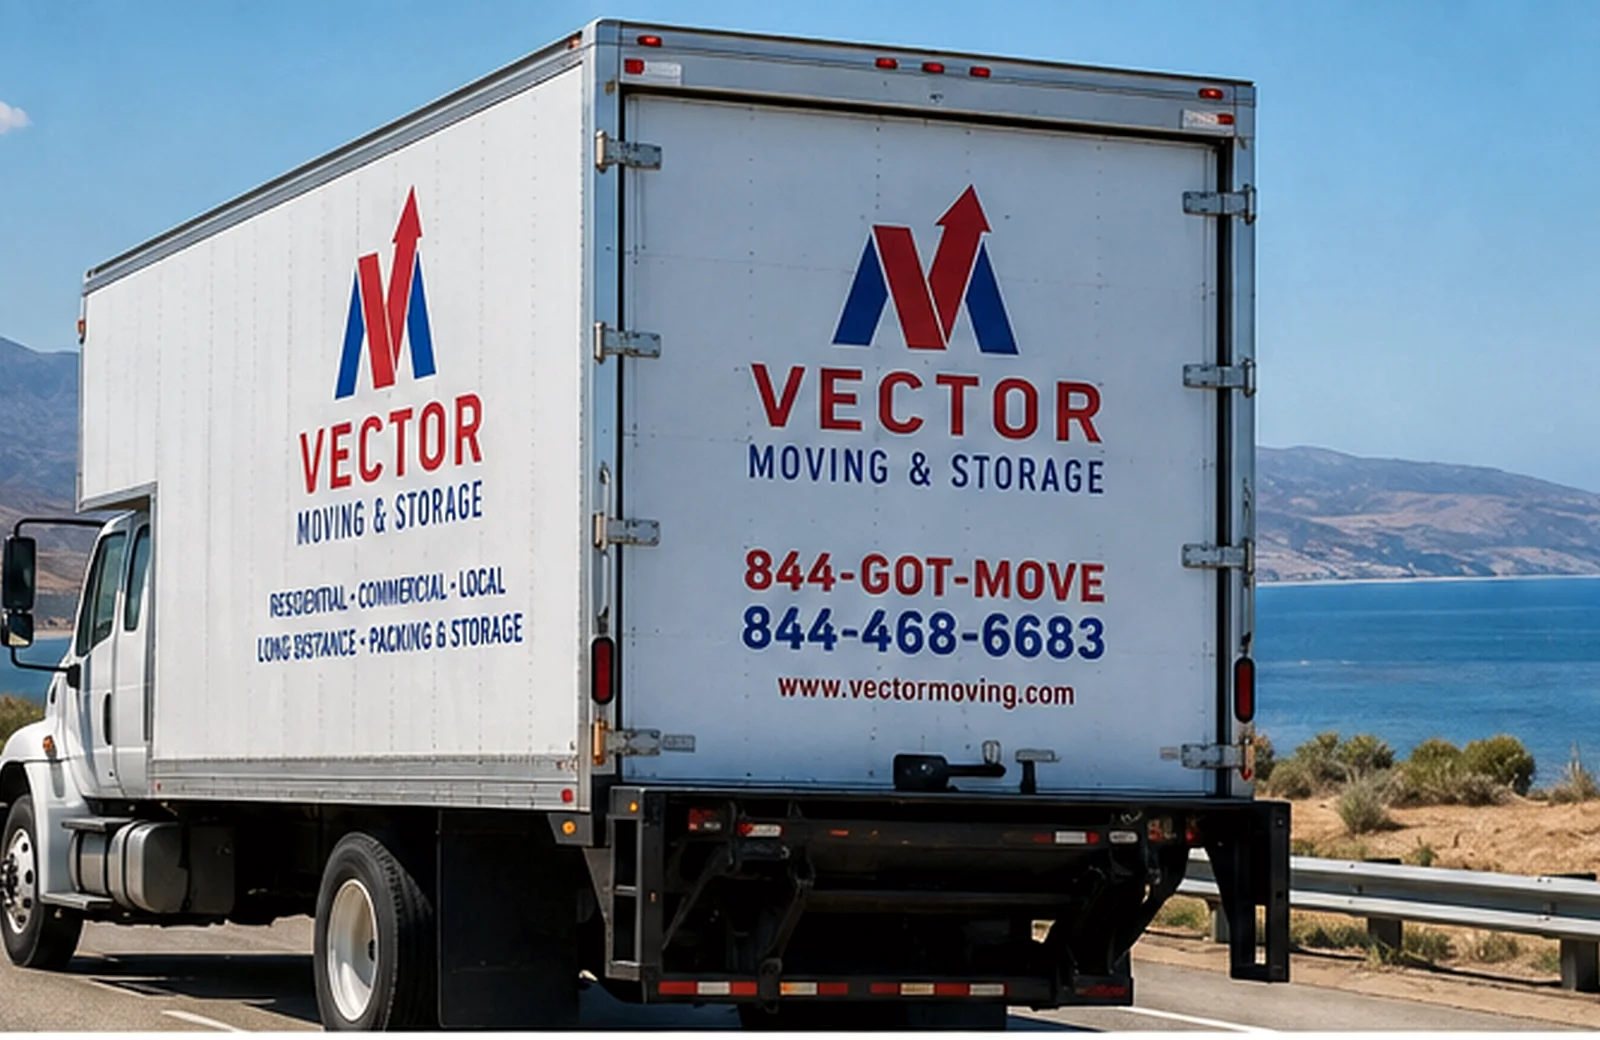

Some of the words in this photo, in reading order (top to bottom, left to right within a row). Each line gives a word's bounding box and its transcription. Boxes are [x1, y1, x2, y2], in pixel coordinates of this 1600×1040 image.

[751, 363, 1103, 443] VECTOR
[299, 393, 483, 494] VECTOR
[748, 444, 888, 484] MOVING
[908, 451, 932, 487] &
[951, 453, 1105, 495] STORAGE
[297, 501, 364, 546] MOVING
[373, 497, 387, 534] &
[395, 480, 483, 530] STORAGE
[458, 566, 506, 598] LOCAL
[744, 549, 1105, 603] 844-GOT-MOVE
[450, 613, 523, 648] STORAGE
[742, 605, 1106, 660] 844-468-6683
[778, 676, 1075, 710] www.vectormoving.com
